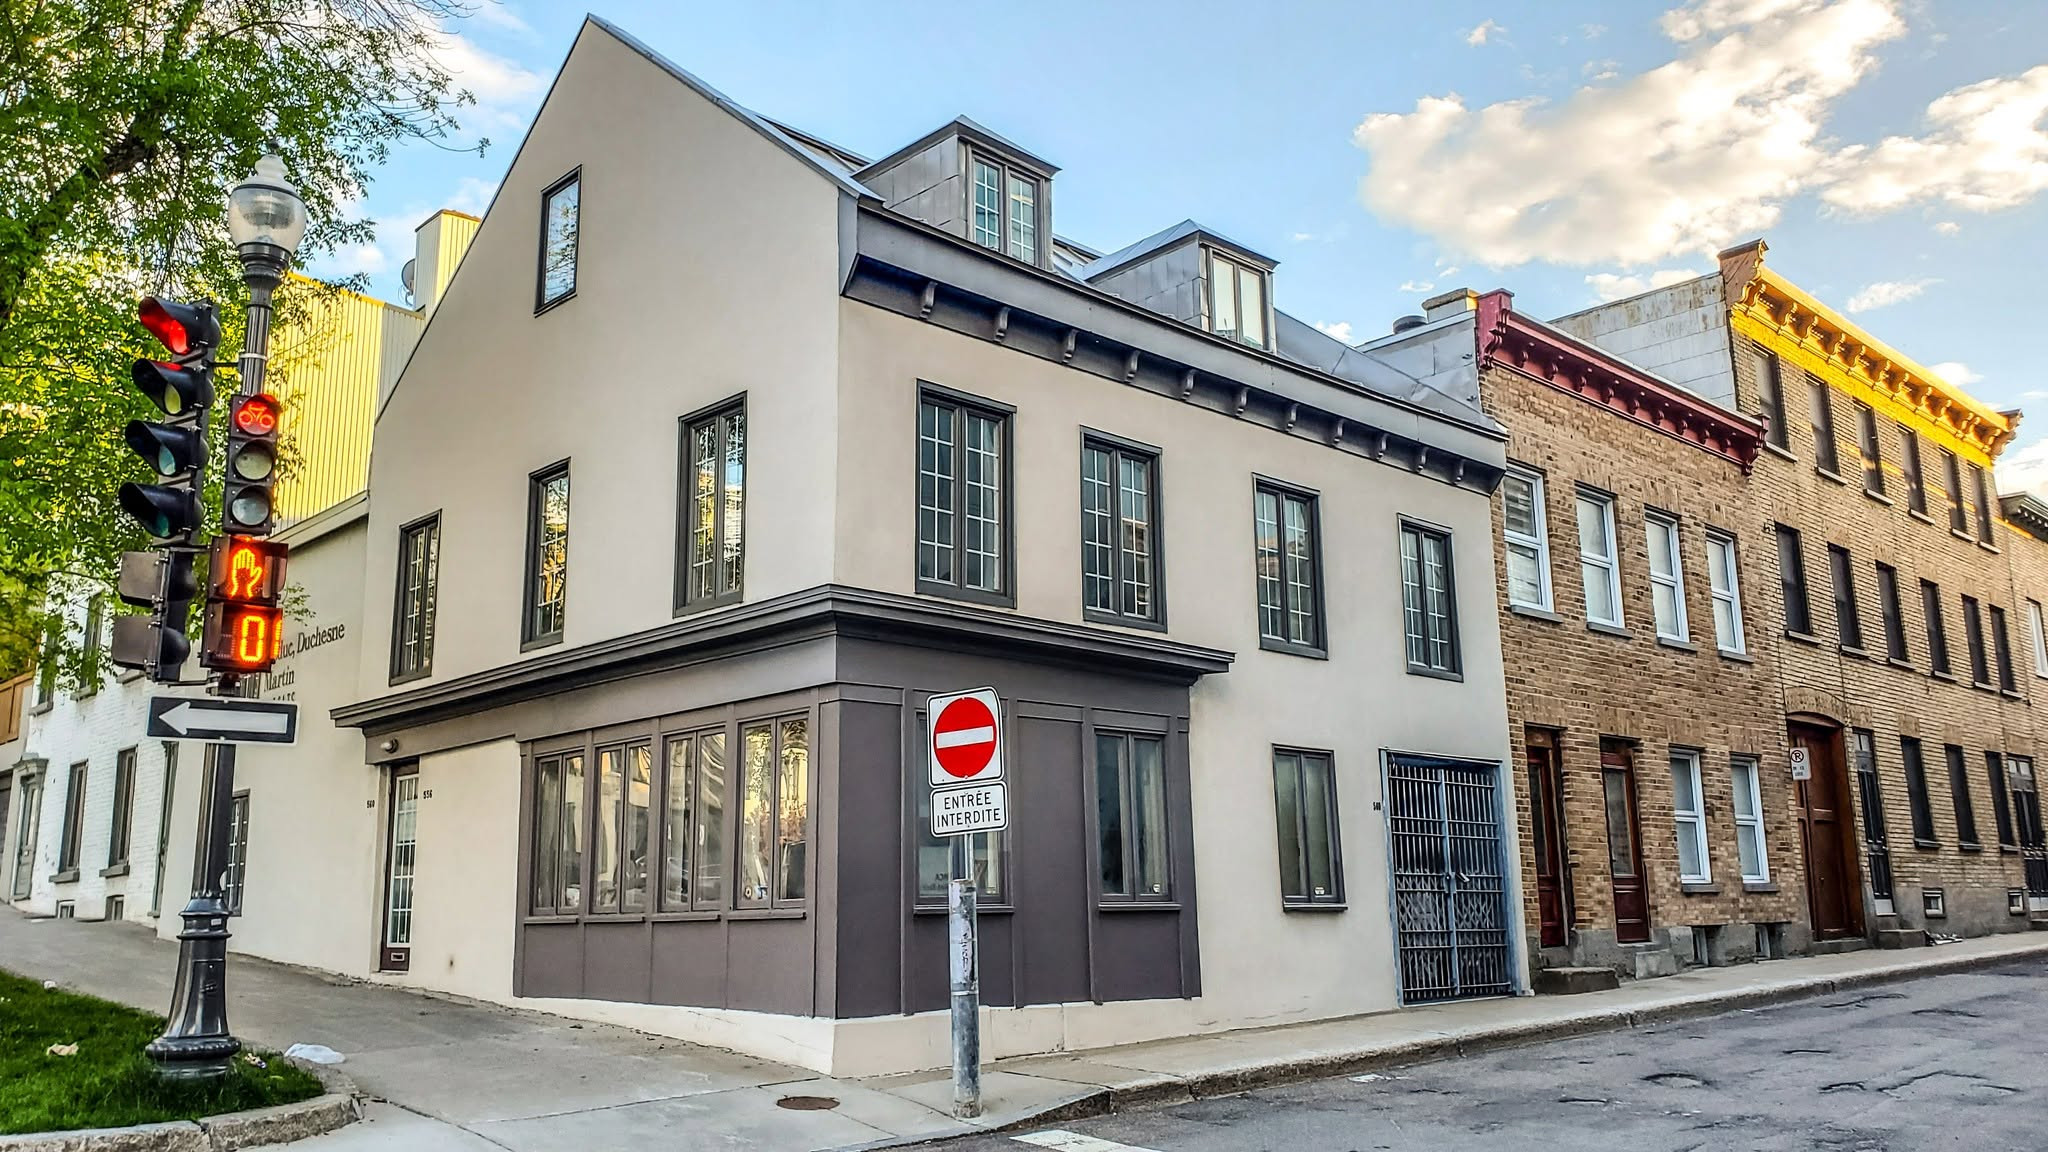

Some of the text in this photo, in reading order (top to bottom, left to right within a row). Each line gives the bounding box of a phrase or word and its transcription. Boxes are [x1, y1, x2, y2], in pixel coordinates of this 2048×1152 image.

[240, 615, 266, 662] 0
[277, 623, 345, 660] duc, Duchesne
[263, 666, 295, 692] Martin
[944, 790, 992, 810] ENTRÉE
[937, 808, 1001, 828] INTERDITE
